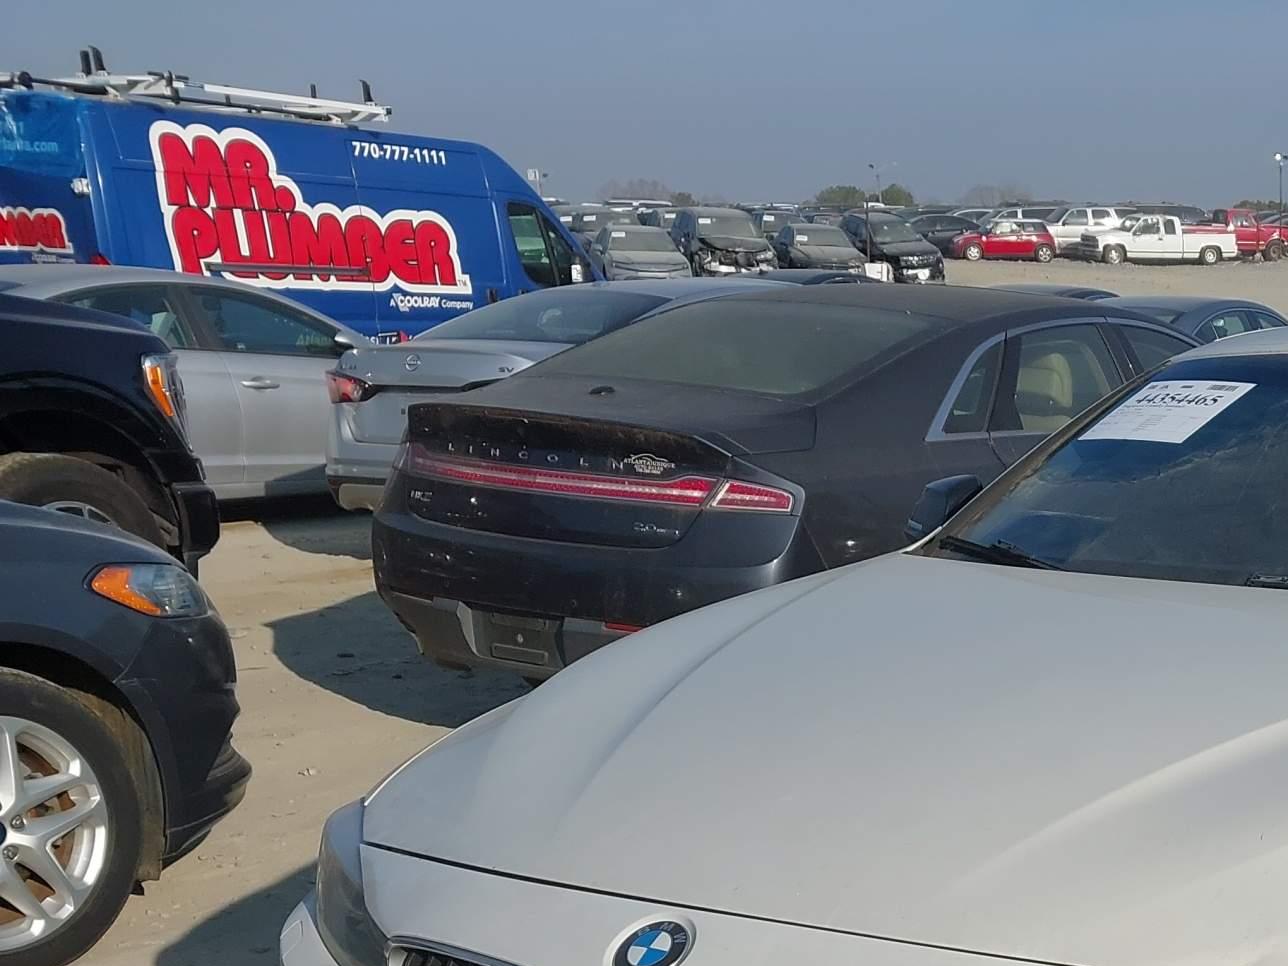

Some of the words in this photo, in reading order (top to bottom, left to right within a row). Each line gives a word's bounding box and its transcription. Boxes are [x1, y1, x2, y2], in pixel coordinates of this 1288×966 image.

[351, 141, 446, 166] 770-777-1111
[158, 131, 296, 213] MR.
[171, 205, 459, 287] PLUMBER
[441, 299, 474, 310] Company
[1135, 393, 1224, 406] 44354465
[448, 442, 624, 470] LINCOLN
